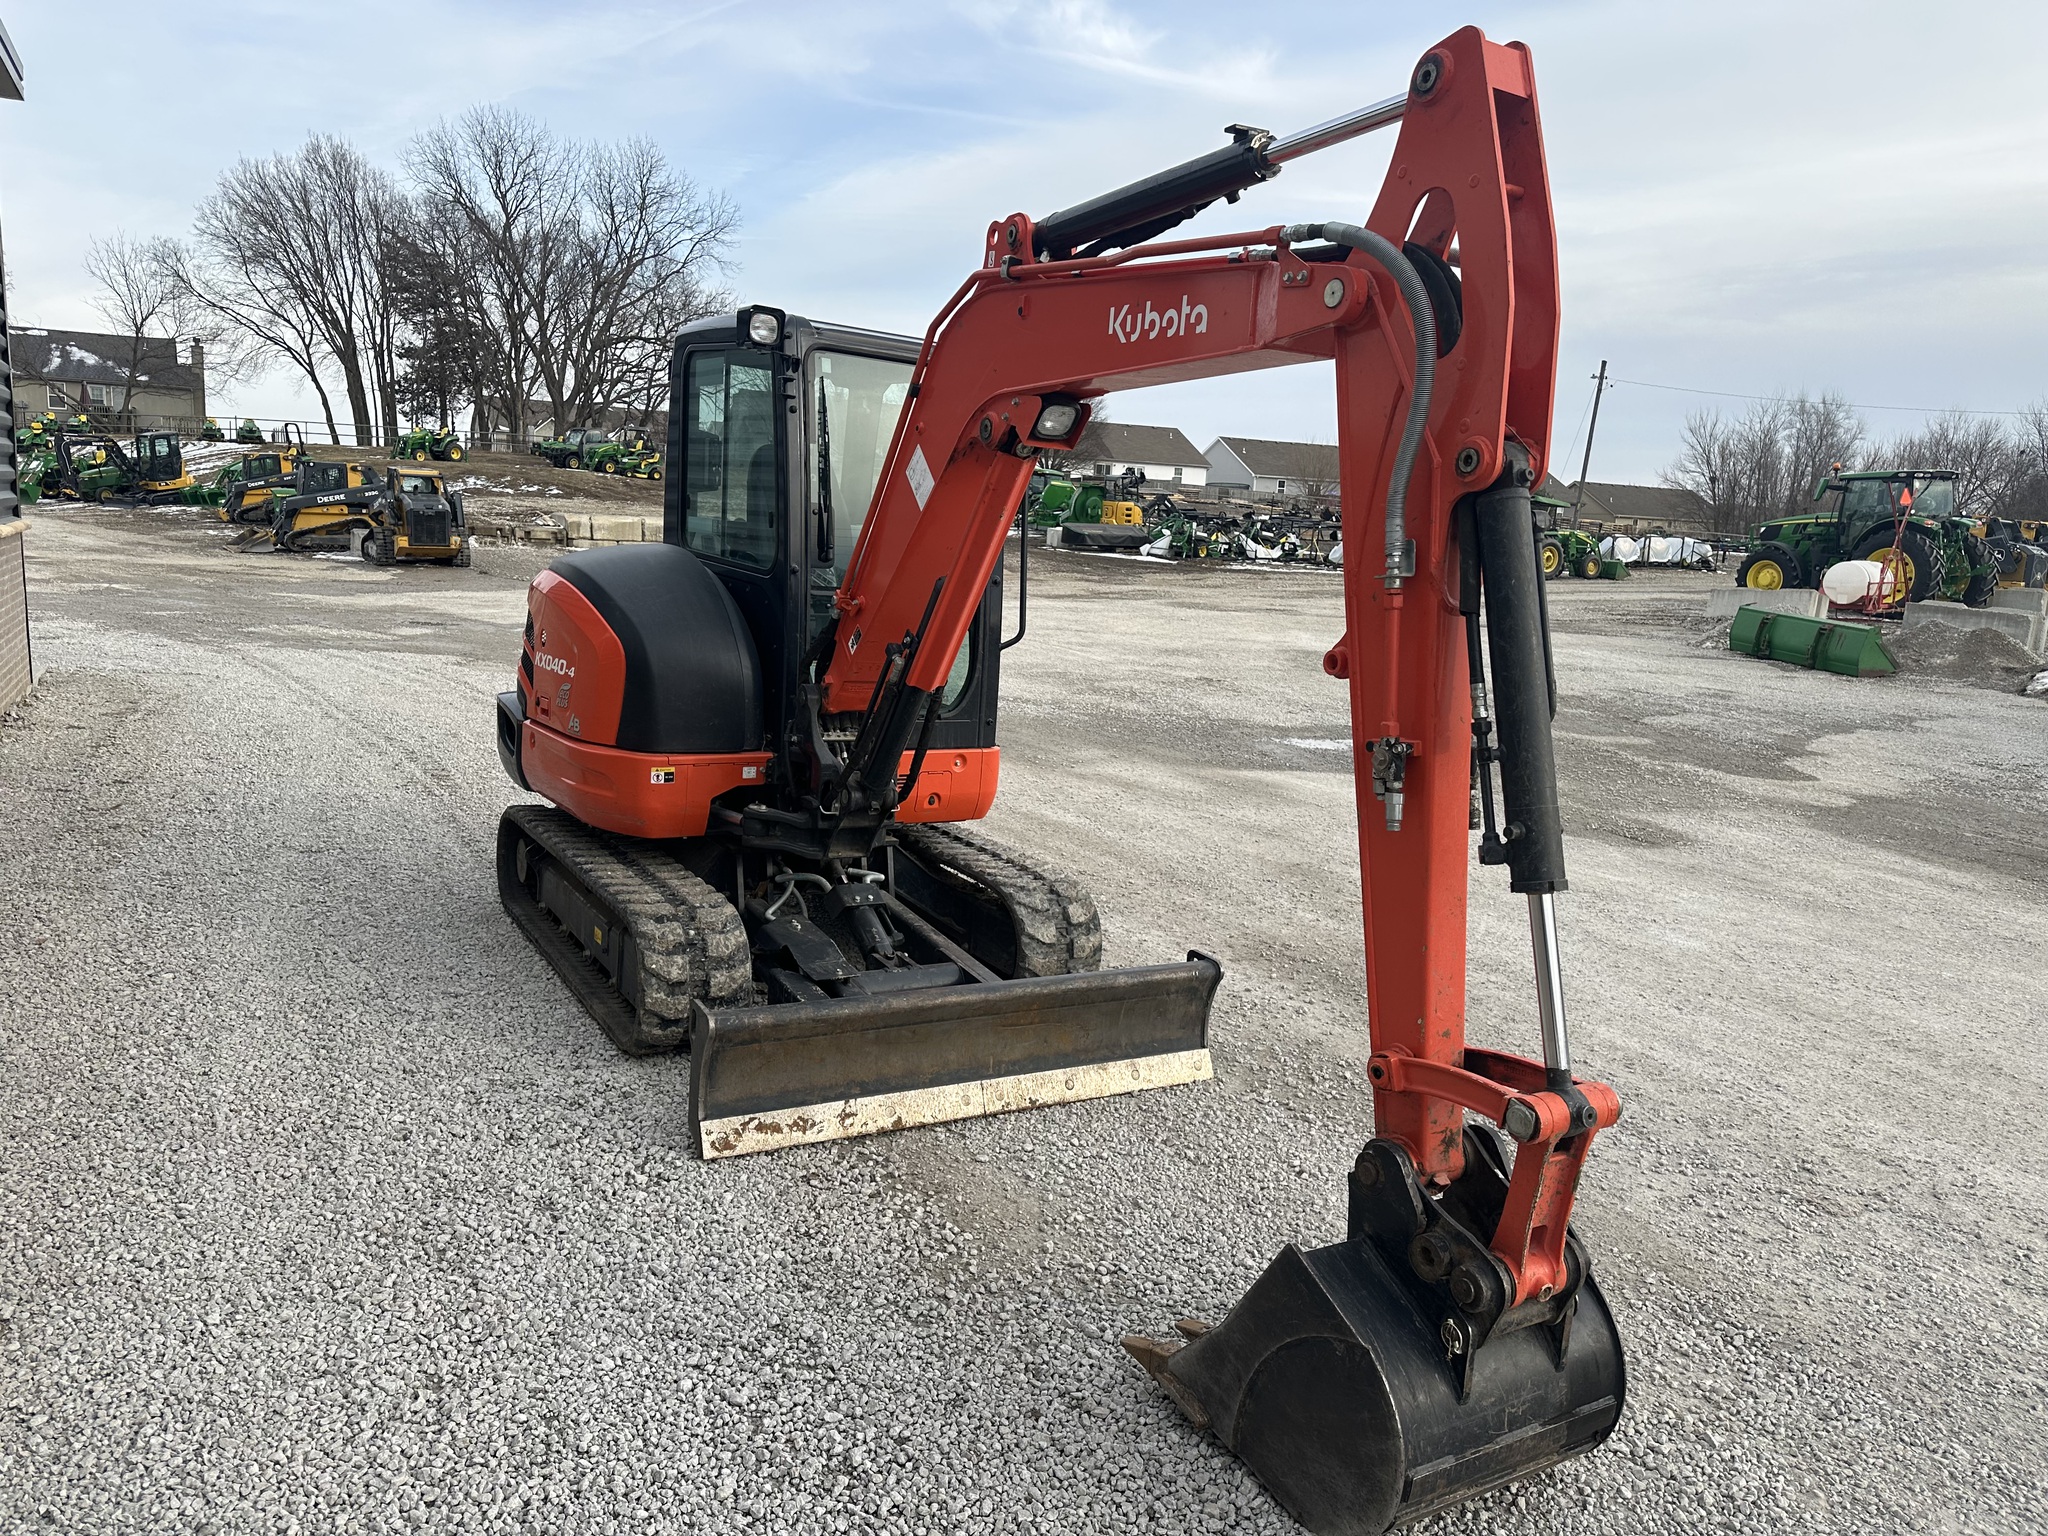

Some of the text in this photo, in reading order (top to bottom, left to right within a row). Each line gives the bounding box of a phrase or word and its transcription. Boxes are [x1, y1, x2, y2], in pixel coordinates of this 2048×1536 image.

[1108, 294, 1208, 344] Kubota
[317, 493, 346, 503] DEERE
[535, 651, 575, 678] KX040-4
